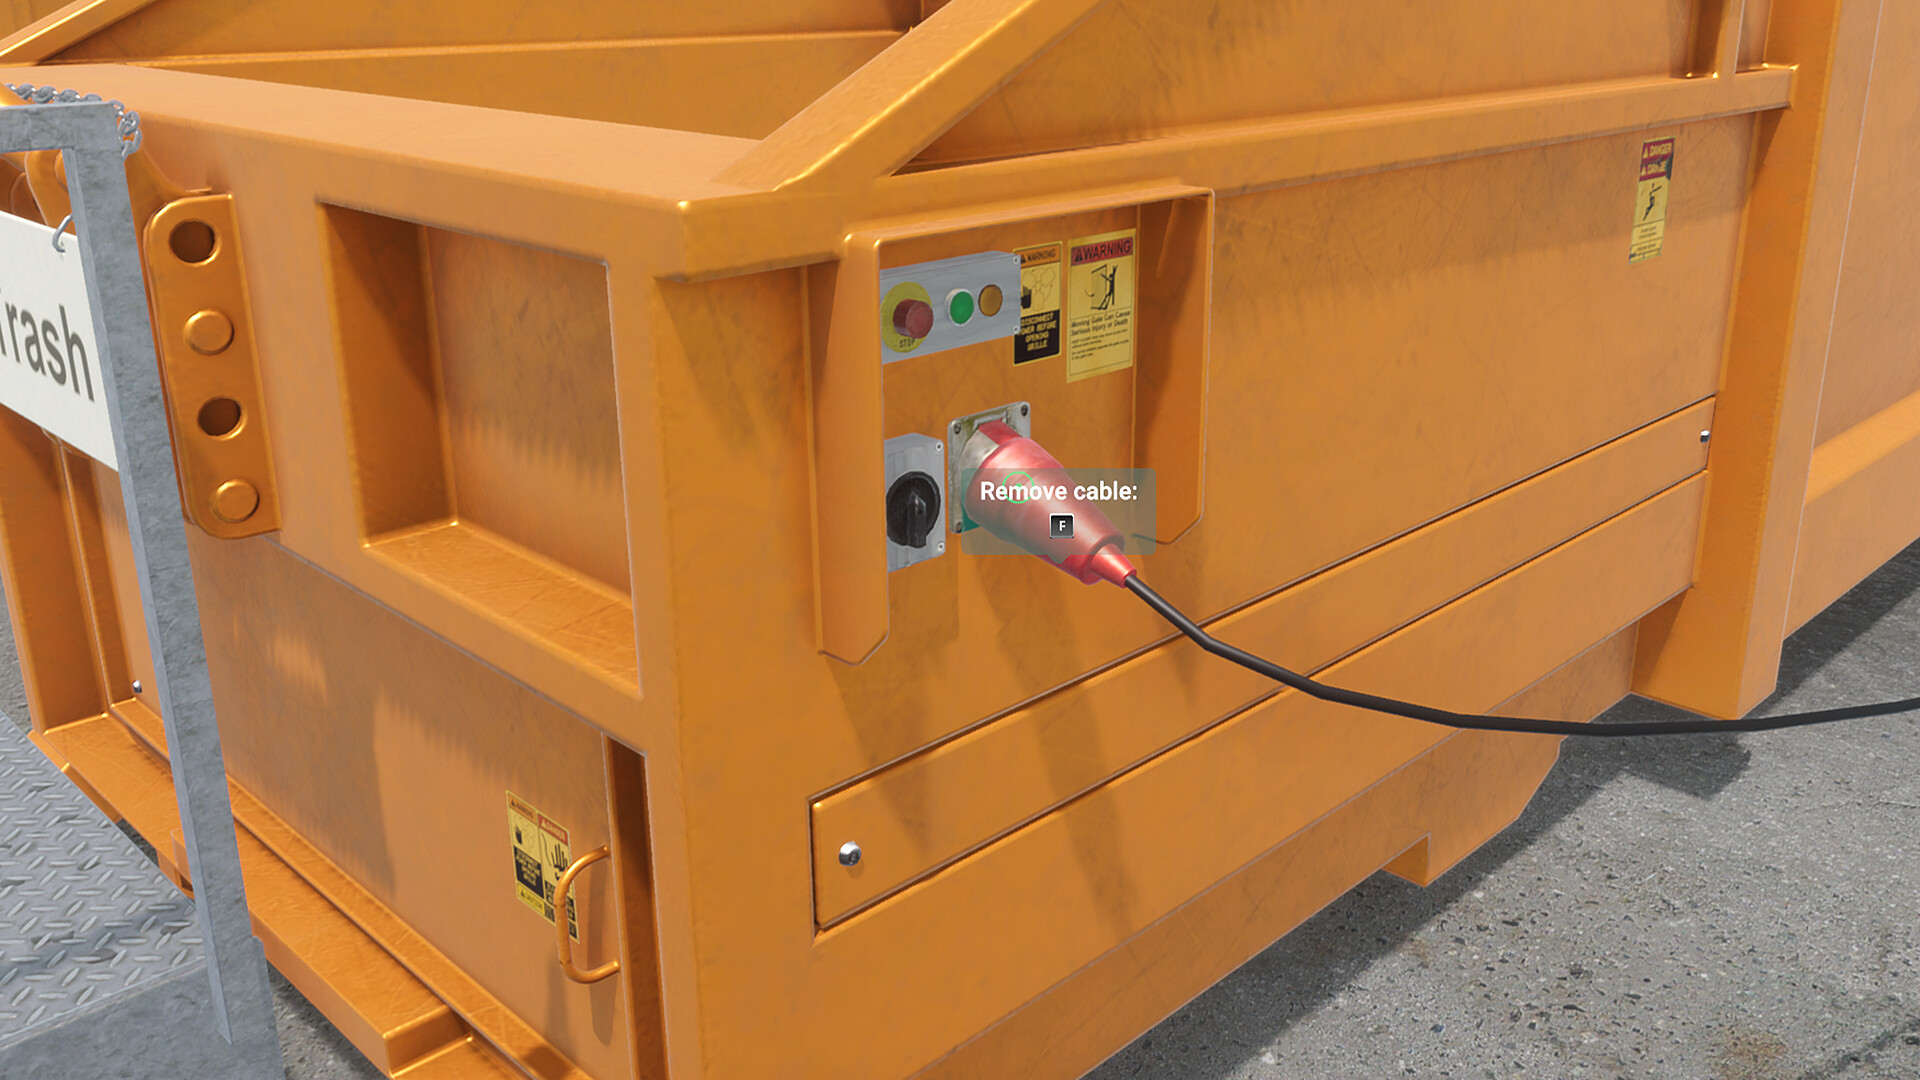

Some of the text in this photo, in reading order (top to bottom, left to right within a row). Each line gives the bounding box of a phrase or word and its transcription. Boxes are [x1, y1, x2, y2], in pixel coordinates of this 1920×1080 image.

[1027, 249, 1056, 261] WARNING
[1083, 240, 1131, 260] WARNING
[899, 338, 916, 349] STOP
